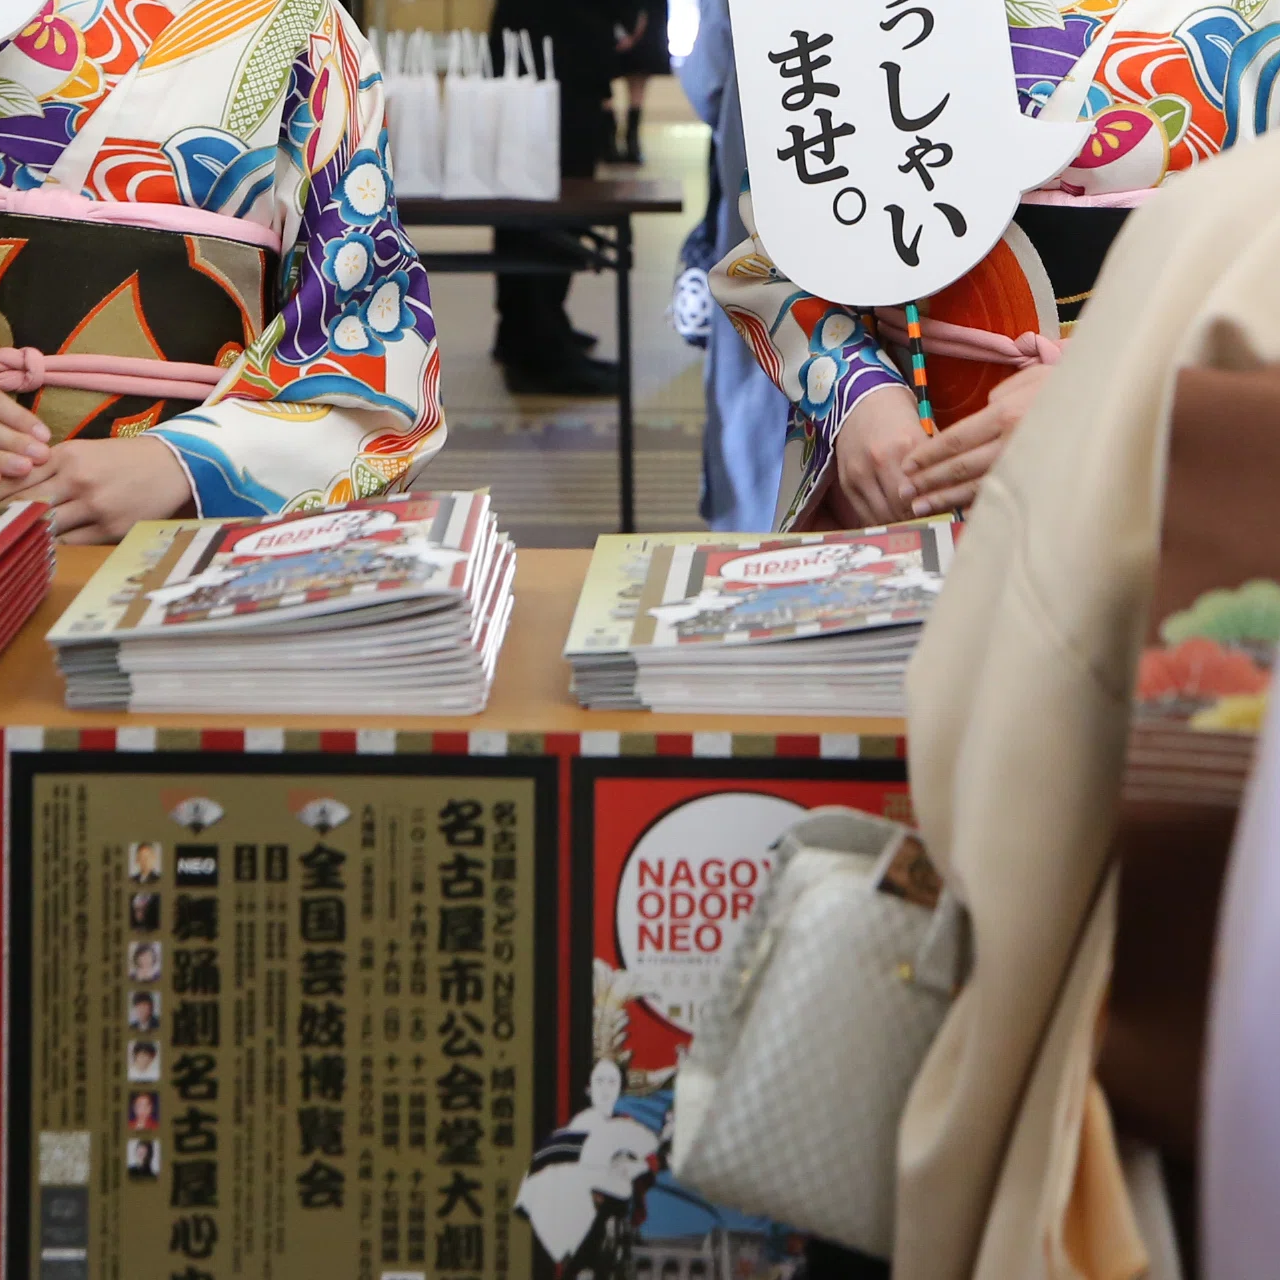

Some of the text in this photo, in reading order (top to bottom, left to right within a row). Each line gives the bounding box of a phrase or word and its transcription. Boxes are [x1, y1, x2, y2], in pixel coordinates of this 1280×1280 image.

[767, 30, 867, 226] ませ。
[177, 857, 217, 875] NEO
[637, 858, 771, 890] NAGO
[637, 923, 722, 952] NEO
[296, 843, 348, 1210] 全国芸妓博覧会
[435, 798, 486, 1280] 名古屋市公会堂大劇
